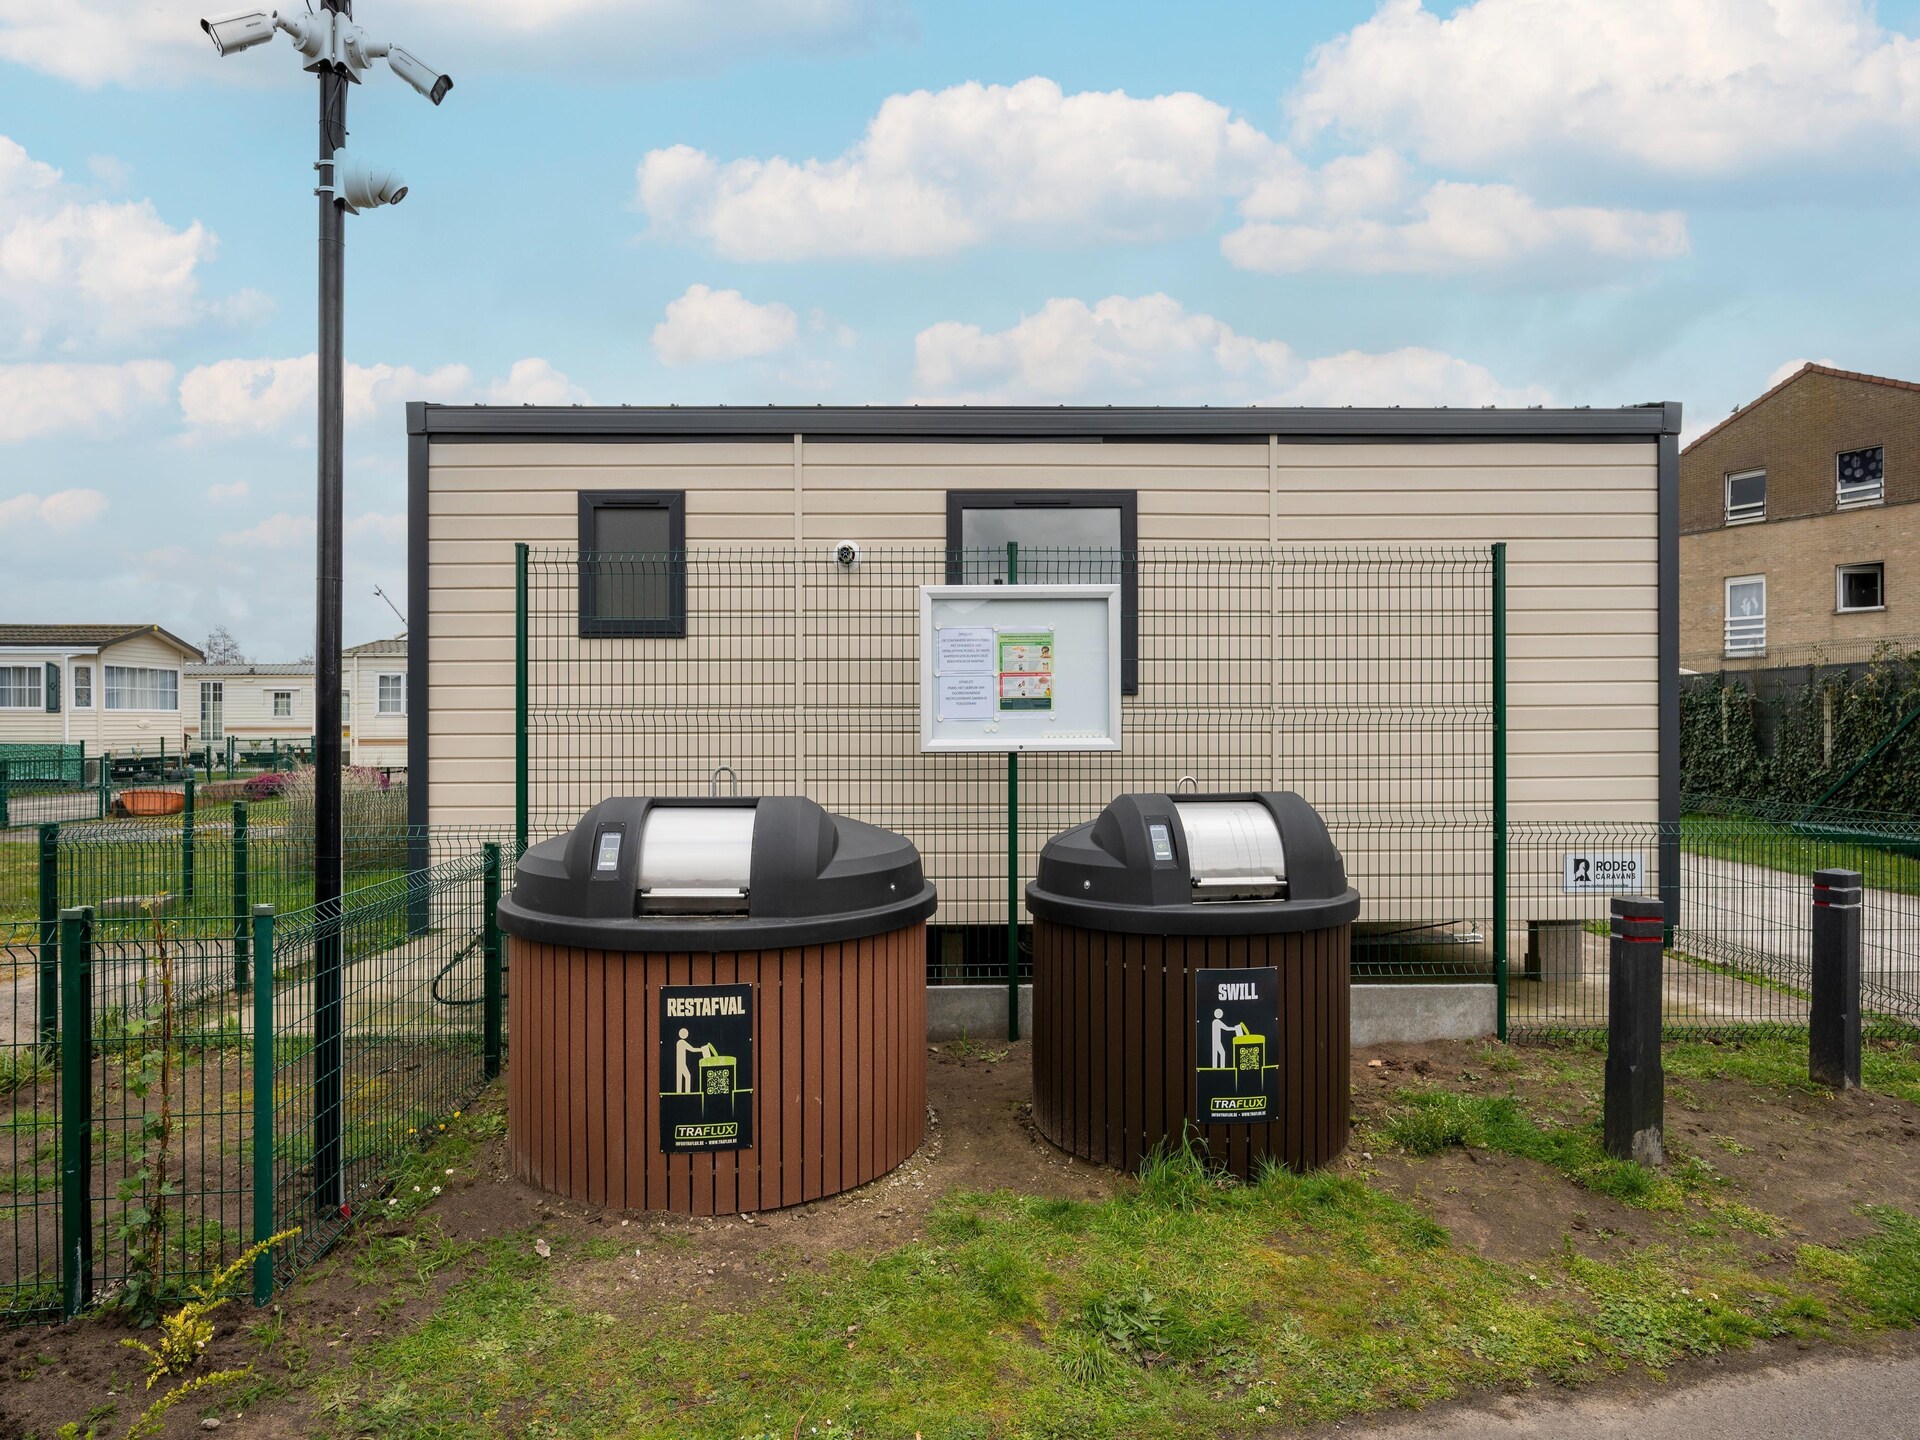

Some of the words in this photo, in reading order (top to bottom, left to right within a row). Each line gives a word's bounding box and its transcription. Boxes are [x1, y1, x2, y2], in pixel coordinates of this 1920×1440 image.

[1596, 860, 1636, 872] RODEO
[1218, 983, 1258, 1001] SWILL
[667, 996, 745, 1017] RESTAFVAL
[1214, 1098, 1264, 1109] TRAFLUX
[678, 1124, 735, 1137] TRAFLUX
